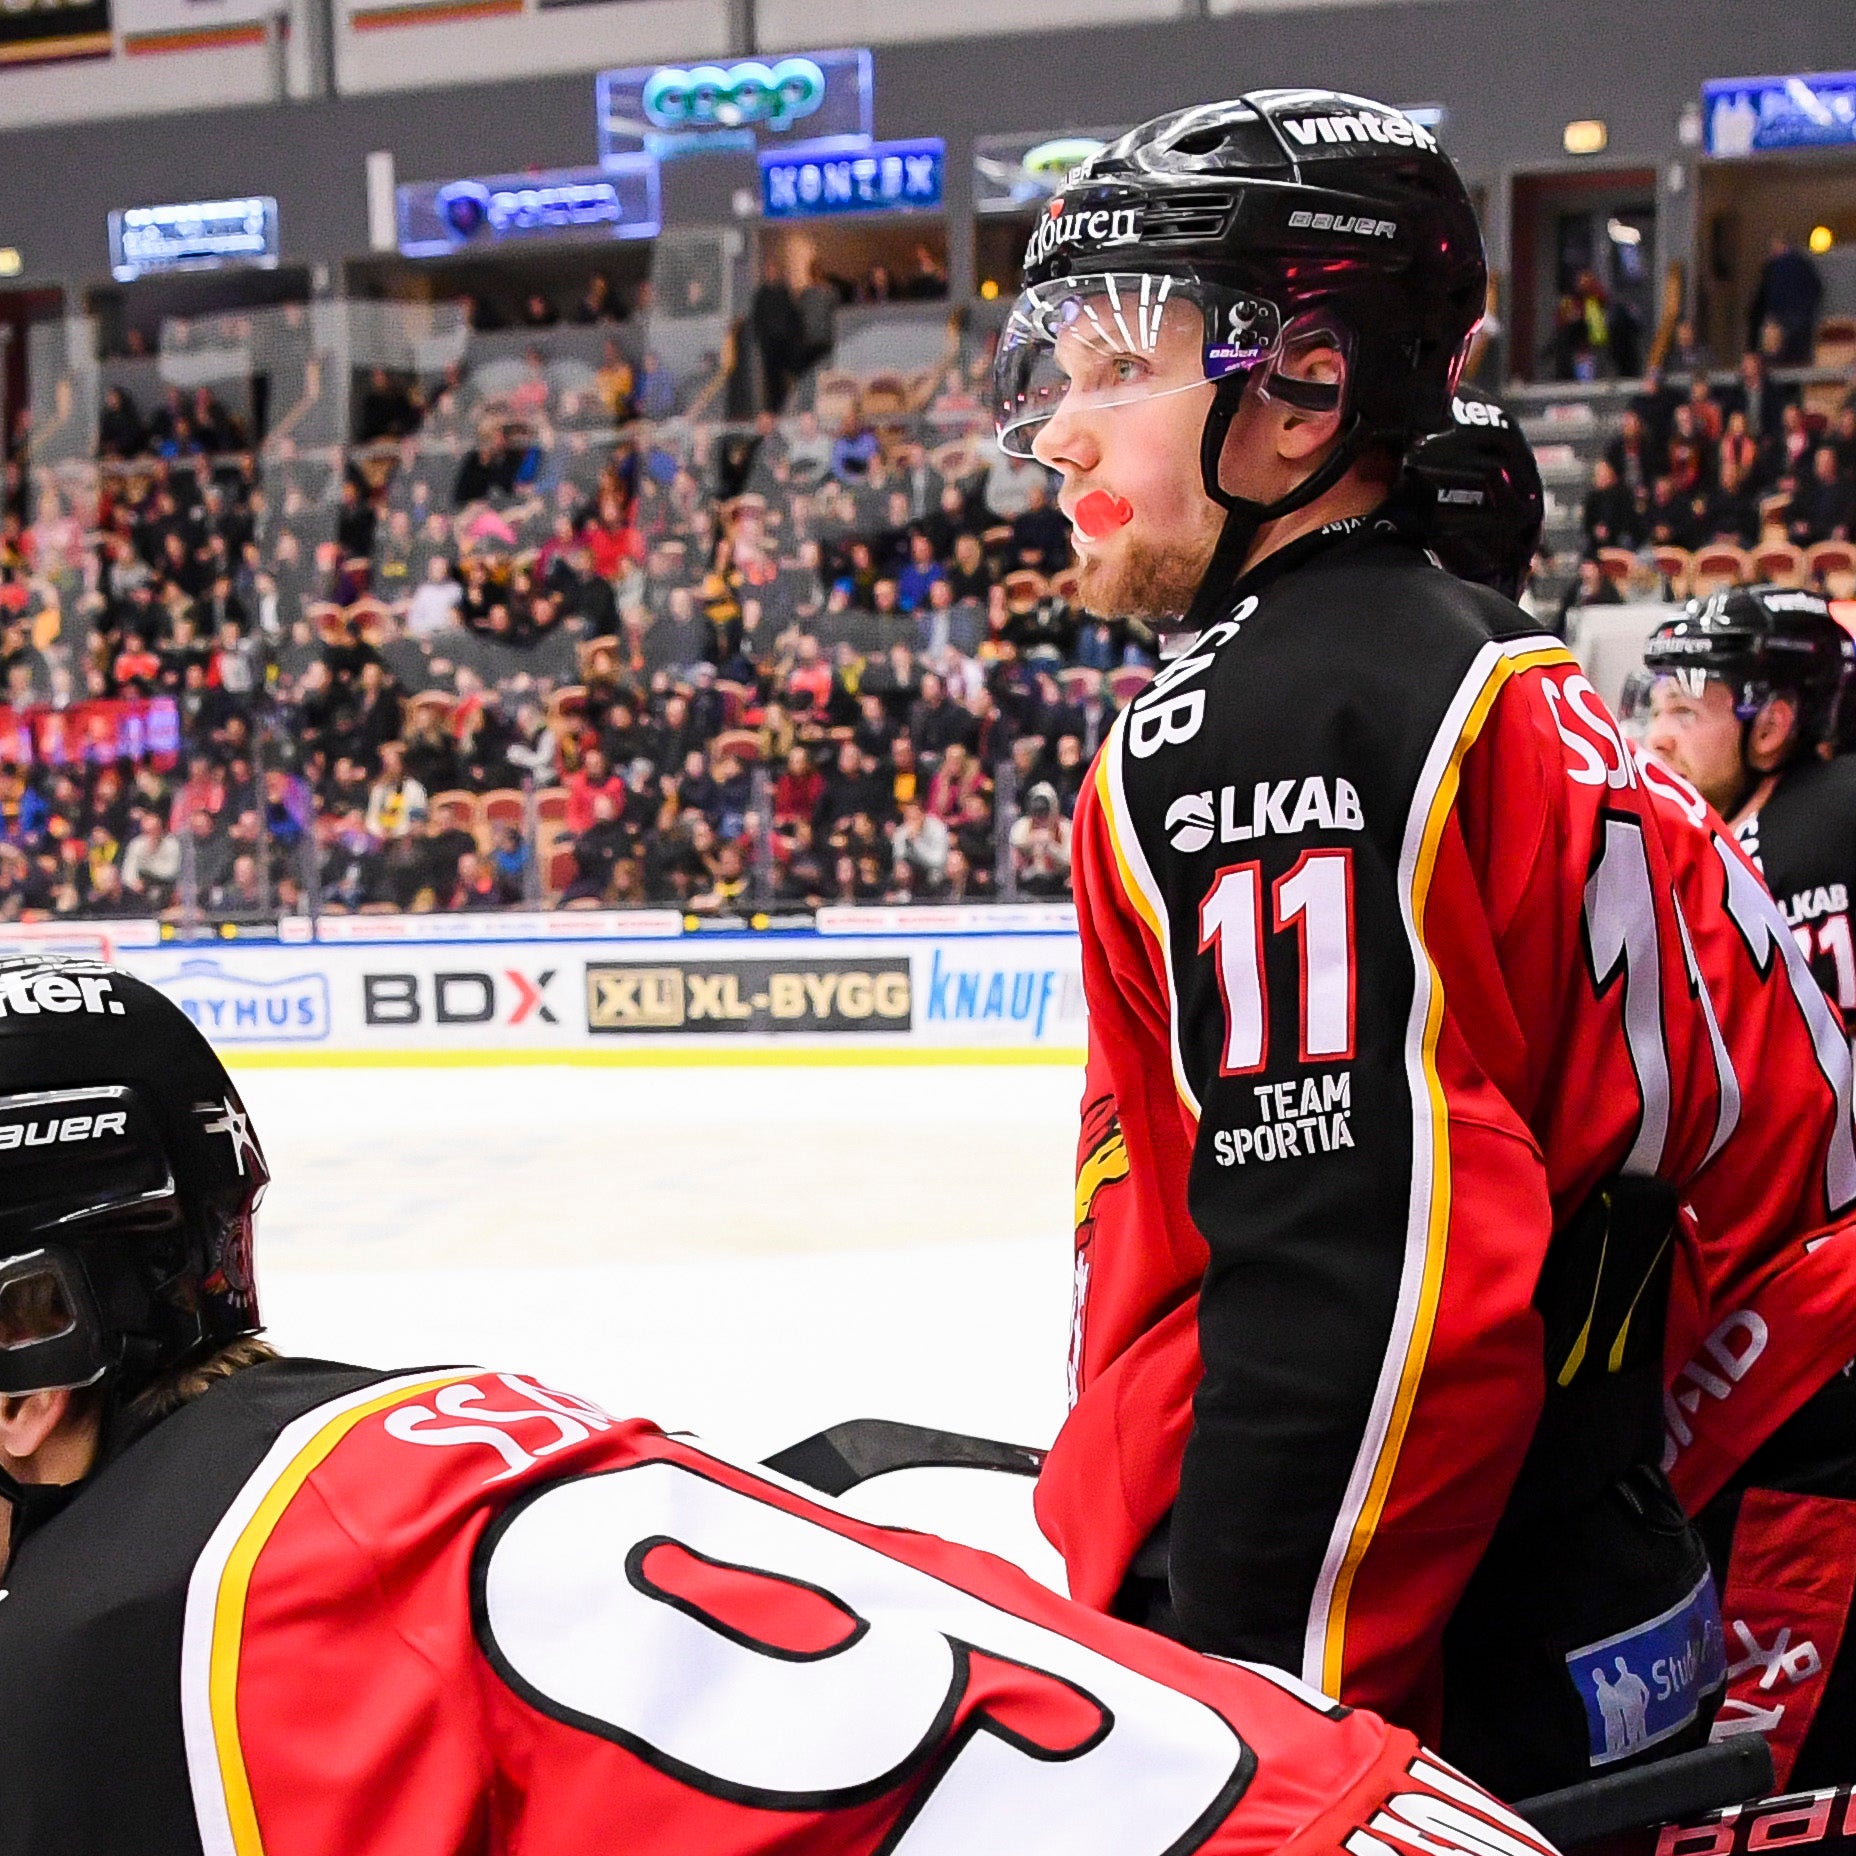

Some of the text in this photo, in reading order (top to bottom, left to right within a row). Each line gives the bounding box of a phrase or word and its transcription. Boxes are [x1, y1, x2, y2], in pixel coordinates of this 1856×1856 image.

[1283, 110, 1438, 152] vinter.
[1288, 210, 1398, 239] BAUER
[1218, 777, 1365, 845] LKAB
[1199, 848, 1358, 1076] 11
[364, 970, 558, 1026] BDX
[687, 971, 911, 1020] XL-BYGG
[1254, 1072, 1352, 1123] TEAM
